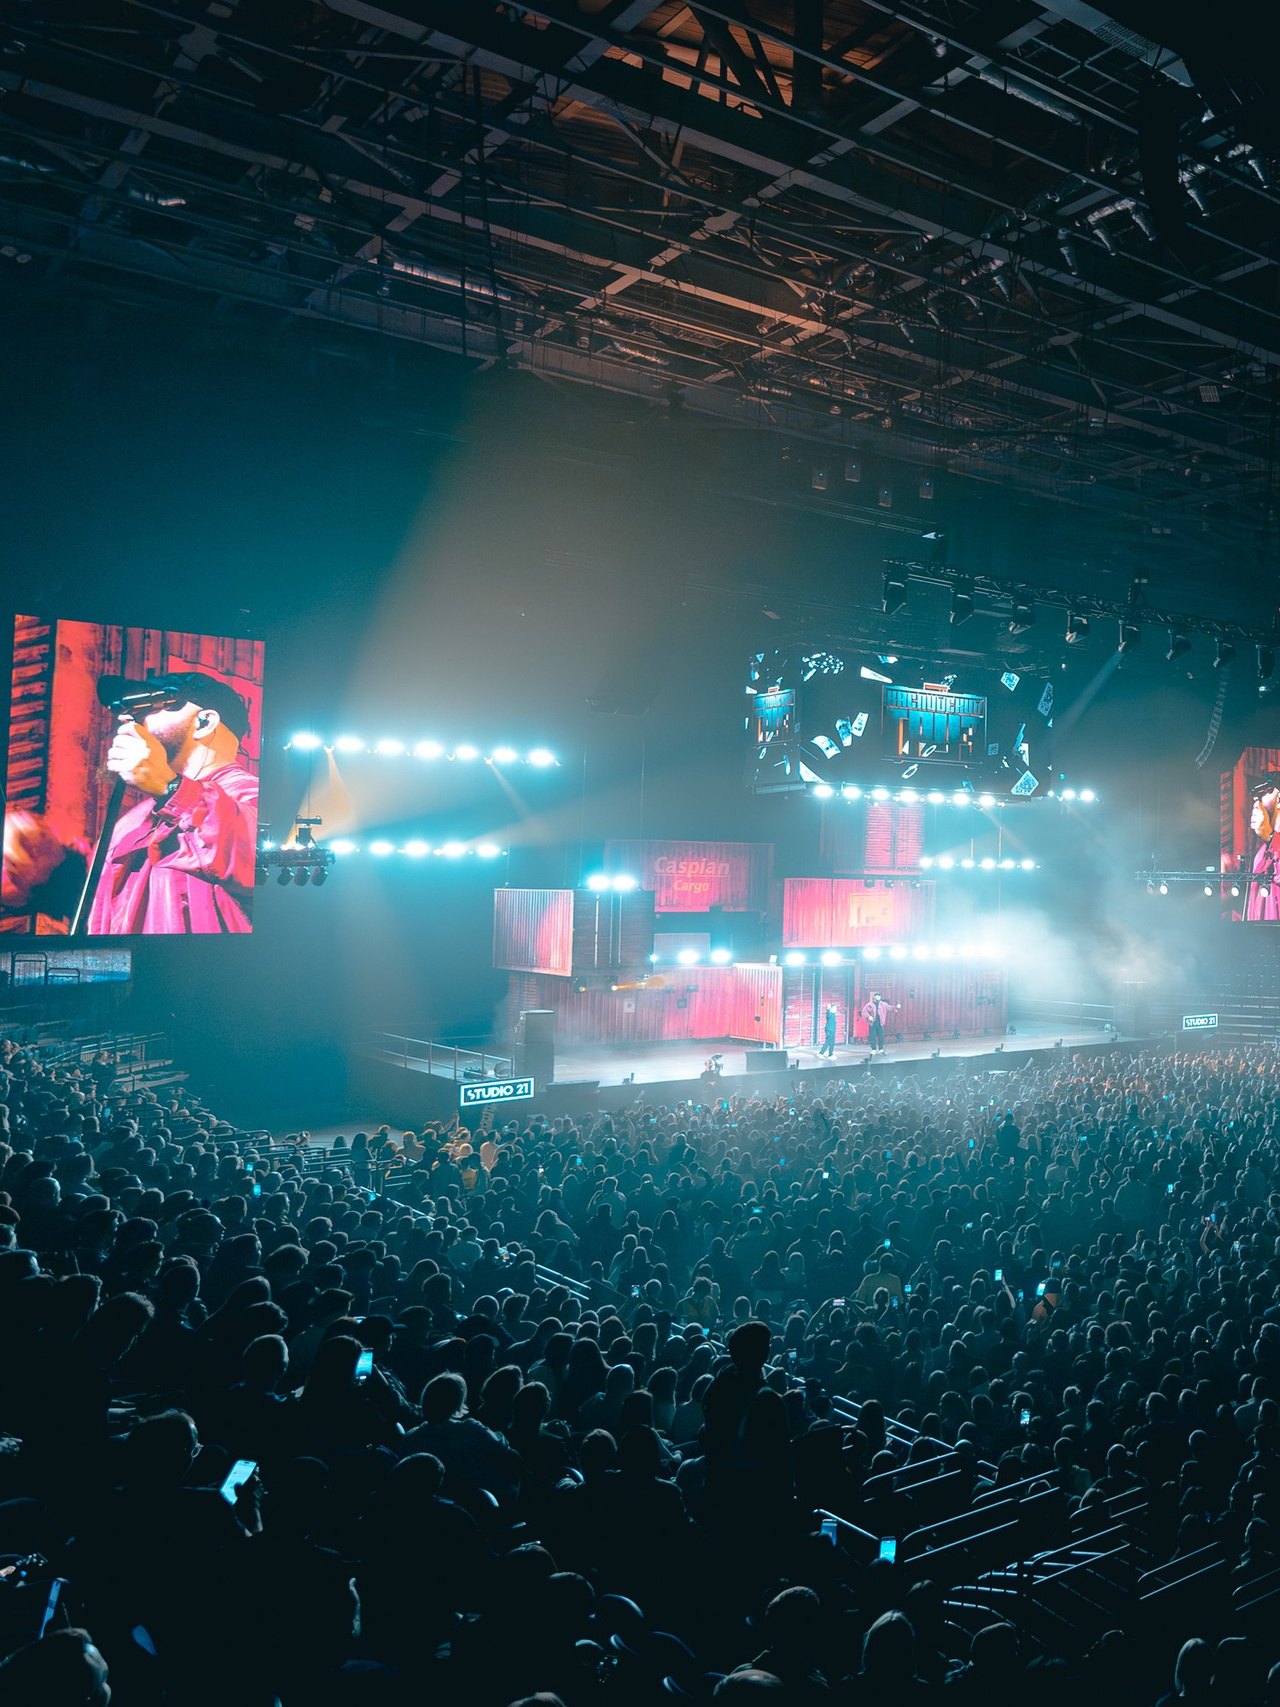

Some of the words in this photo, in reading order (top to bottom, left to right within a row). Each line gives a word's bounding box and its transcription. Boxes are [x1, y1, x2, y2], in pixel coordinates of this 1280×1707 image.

[886, 690, 984, 716] КАСПИЙСКИЙ
[655, 856, 730, 878] Caspian
[673, 880, 709, 893] Cargo
[1186, 1017, 1208, 1027] STUDIO
[1209, 1016, 1216, 1025] 21
[466, 1085, 514, 1101] STUDIO
[516, 1082, 529, 1095] 21
